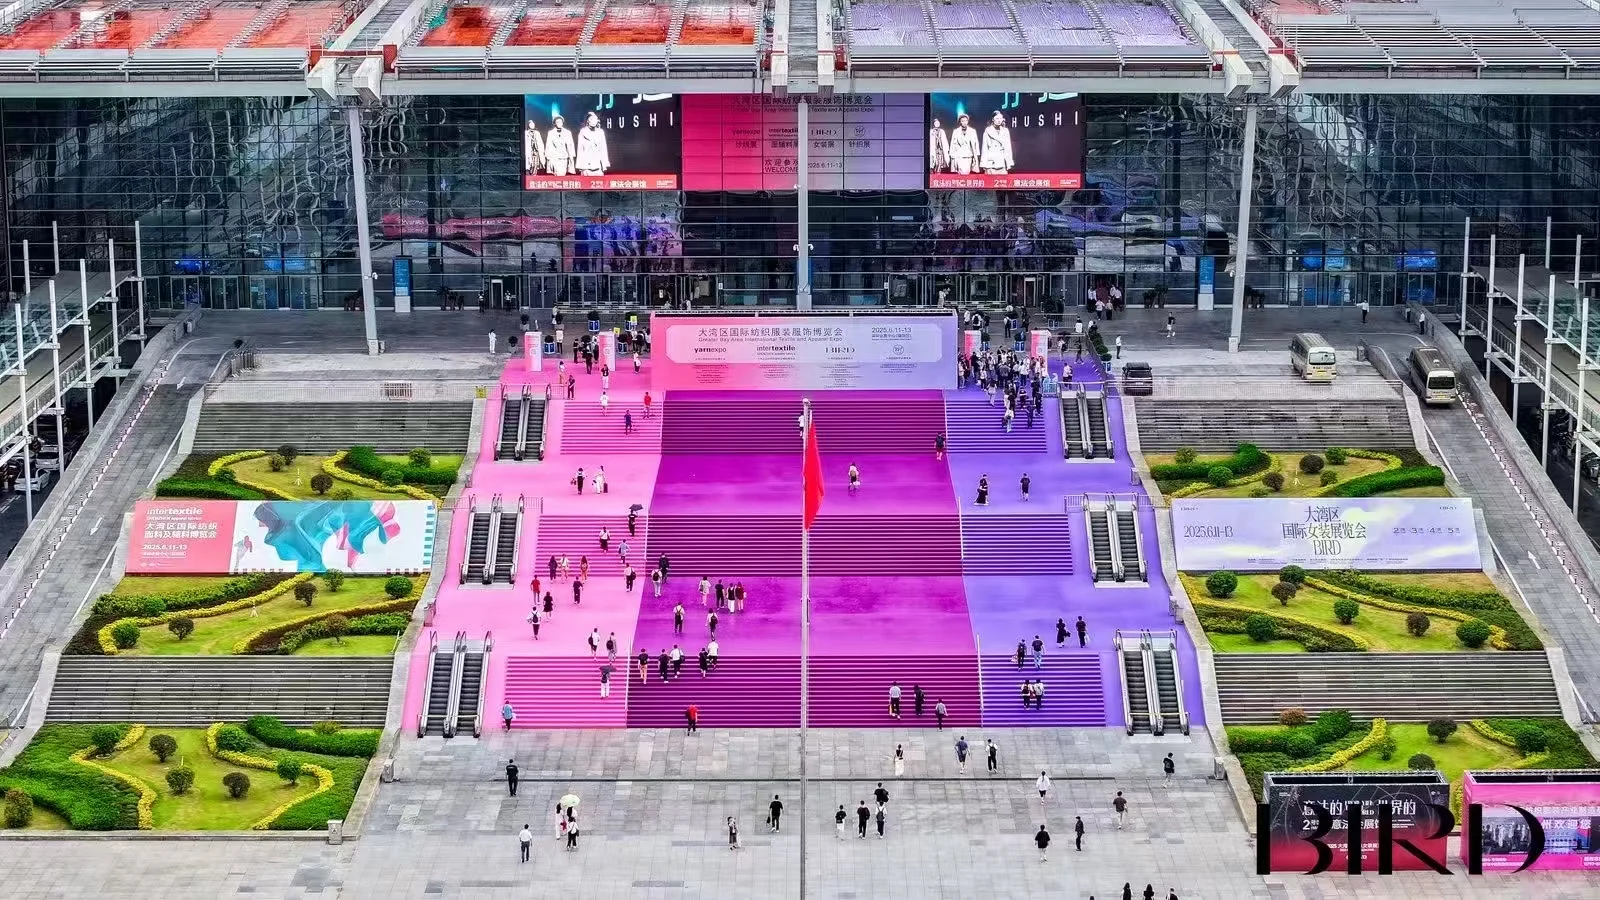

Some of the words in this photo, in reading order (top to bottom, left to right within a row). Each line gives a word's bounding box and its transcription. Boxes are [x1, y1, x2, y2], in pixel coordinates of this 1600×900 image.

[698, 327, 843, 337] 大湾区国际纺织服装服饰博览会
[694, 346, 727, 354] yarnexpo
[147, 507, 203, 515] intertextile
[1304, 506, 1341, 522] 大湾区
[146, 522, 218, 530] 大湾区国际纺织
[1281, 522, 1366, 539] 国际女装展览会
[1313, 539, 1341, 556] BIRD
